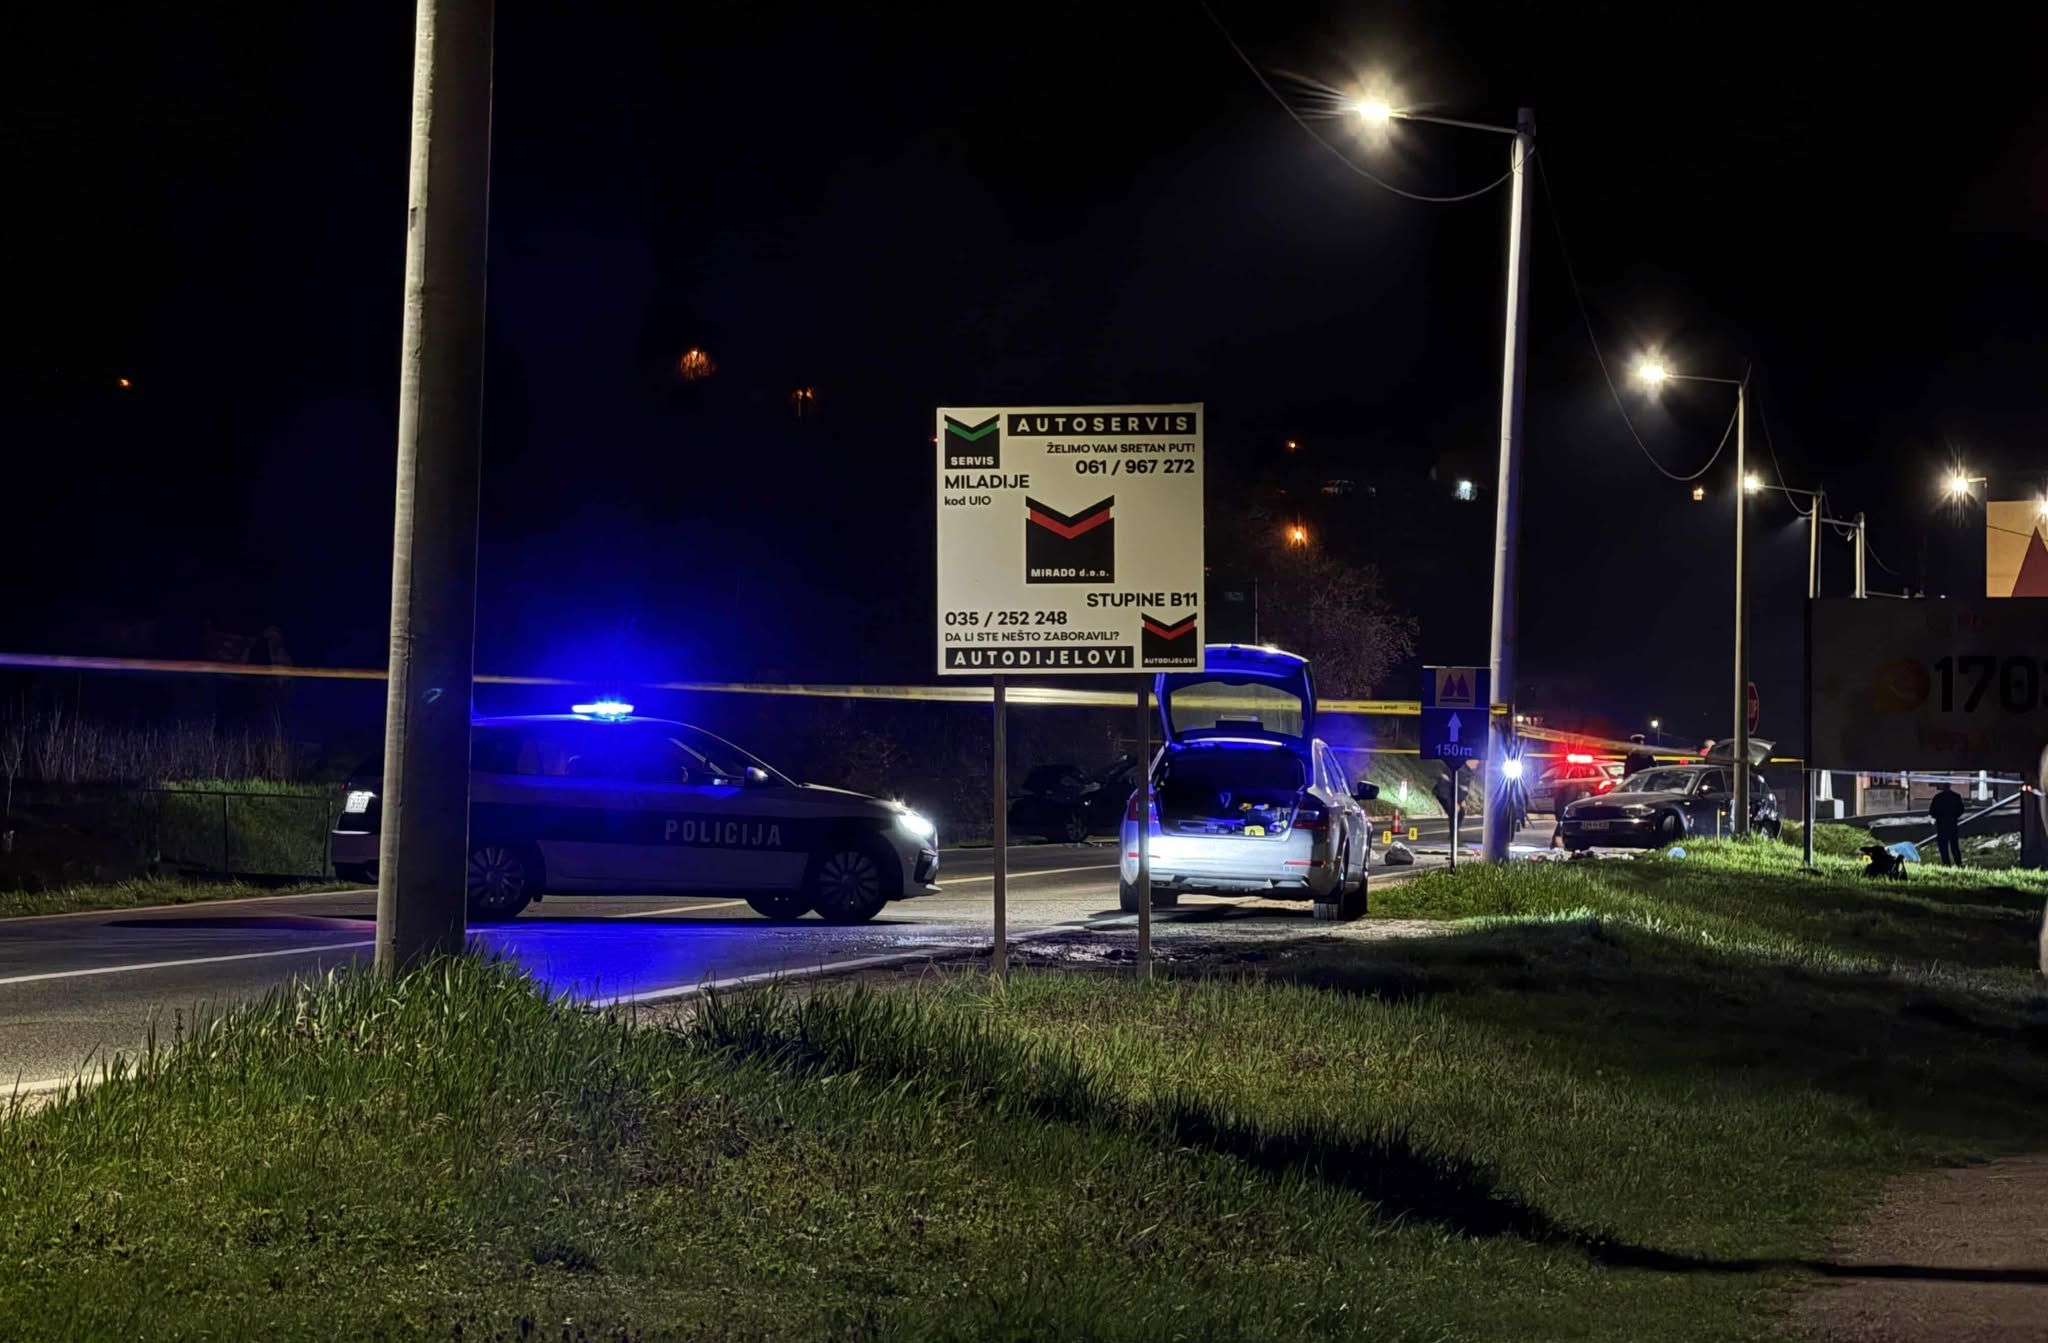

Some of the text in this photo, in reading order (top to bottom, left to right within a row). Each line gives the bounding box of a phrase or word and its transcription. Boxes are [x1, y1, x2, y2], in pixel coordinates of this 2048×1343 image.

[1017, 417, 1187, 433] AUTOSERVIS
[1047, 442, 1195, 454] ŽELIMO VAM SRETAN PUT!
[951, 456, 994, 466] SERVIS
[1076, 459, 1195, 475] 061 / 967 272
[945, 475, 1030, 489] MILADIJE
[945, 495, 992, 506] kod UIO
[1031, 568, 1109, 577] MIRADO d.o.o.
[1087, 593, 1198, 608] STUPINE B11
[946, 611, 1068, 627] 035 / 252 248
[946, 629, 1120, 642] DA LI STE NEŠTO ZABORAVILI?
[955, 650, 1126, 666] AUTODIJELOVI
[1934, 655, 2048, 714] 170
[1435, 743, 1472, 757] 150m
[664, 819, 782, 846] POLICIJA
